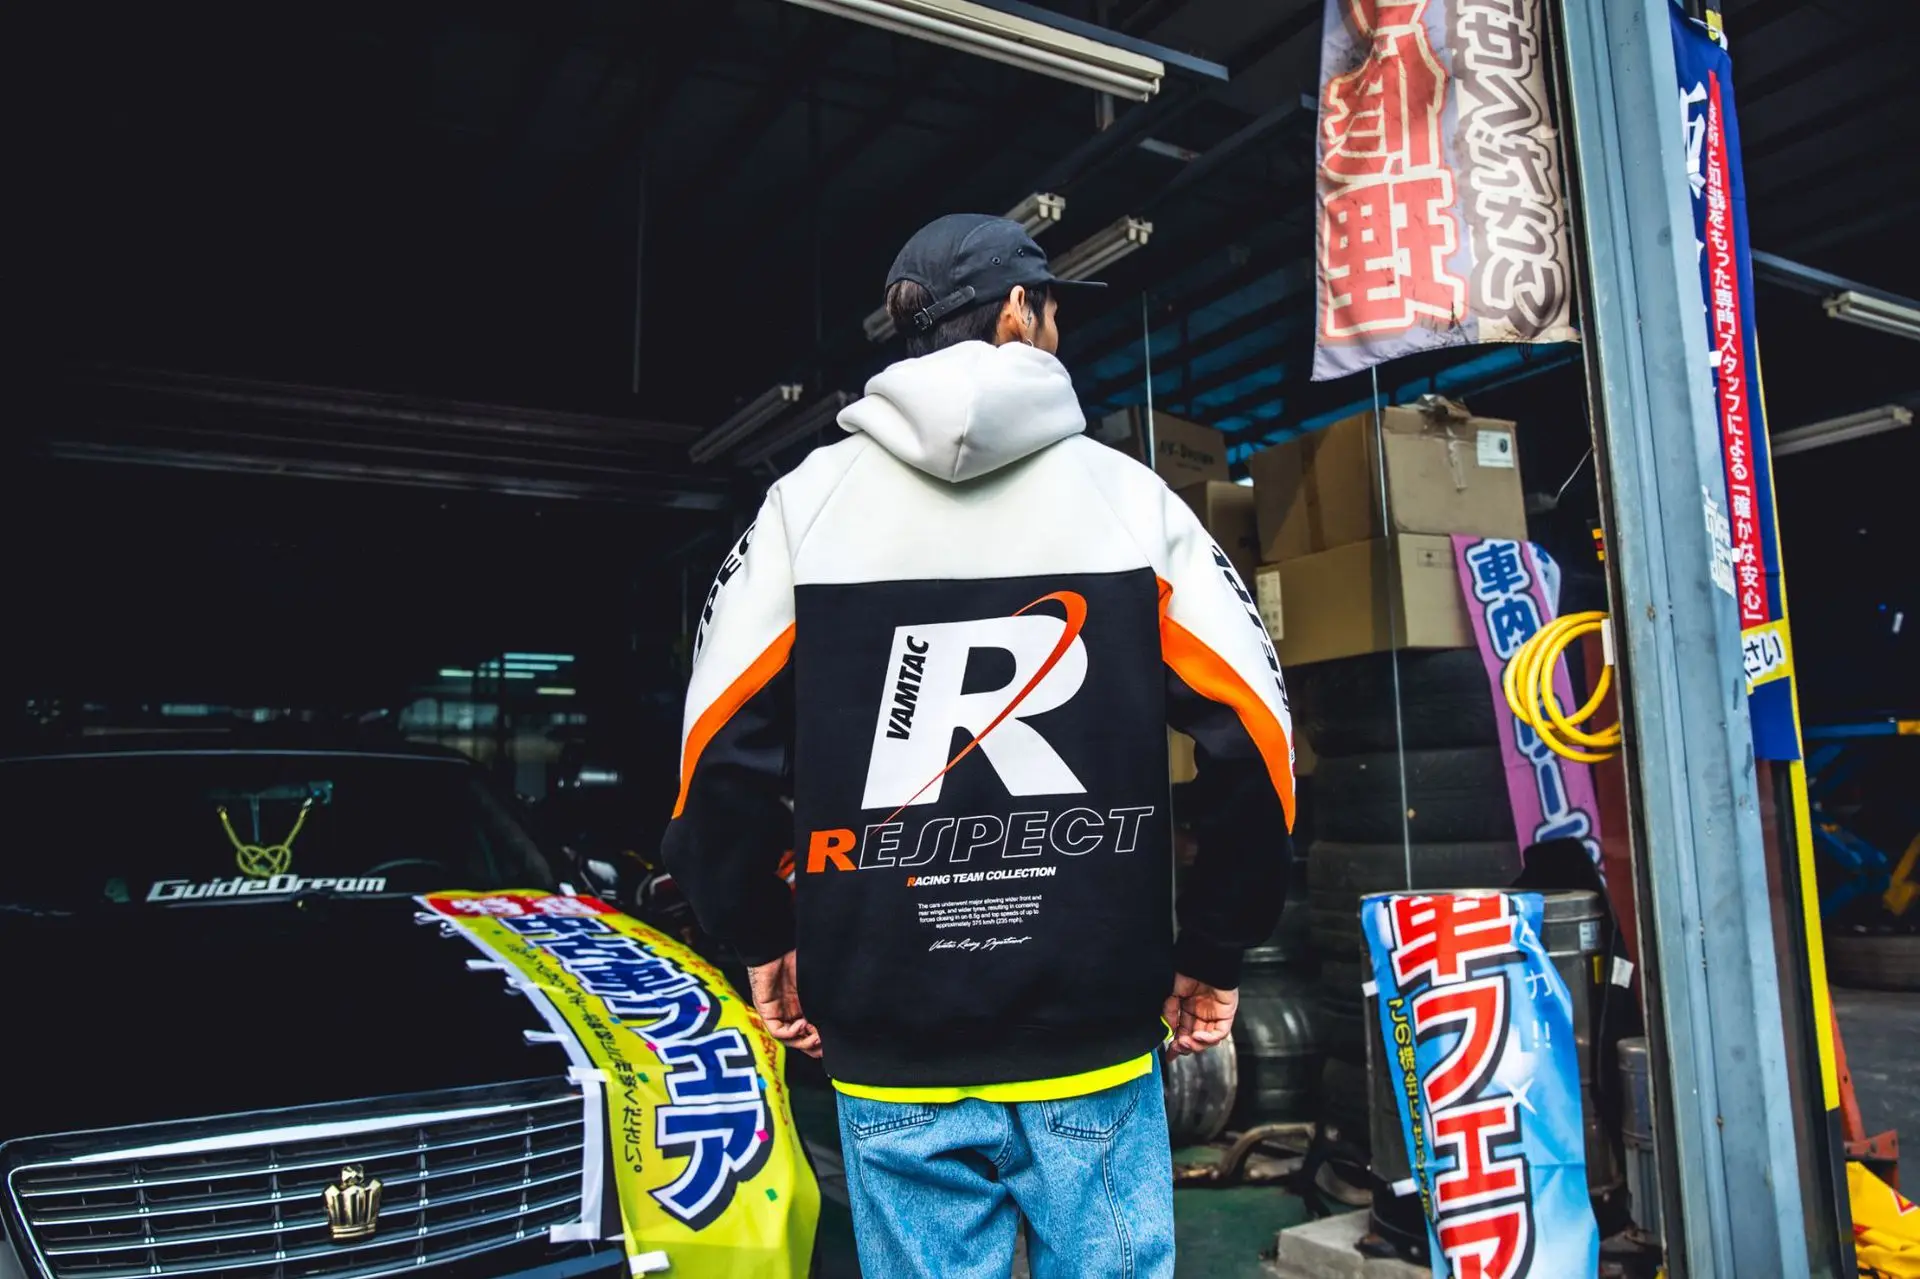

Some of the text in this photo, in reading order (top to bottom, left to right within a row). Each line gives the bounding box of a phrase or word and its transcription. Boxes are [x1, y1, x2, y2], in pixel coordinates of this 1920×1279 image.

[1743, 635, 1783, 678] さい
[886, 634, 930, 740] VAMTAC
[861, 614, 1088, 810] R
[806, 806, 1154, 873] RESPECT
[146, 874, 386, 902] GuideDream
[906, 867, 1056, 887] RACING TEAM COLLECTION
[1001, 909, 1019, 917] speeds
